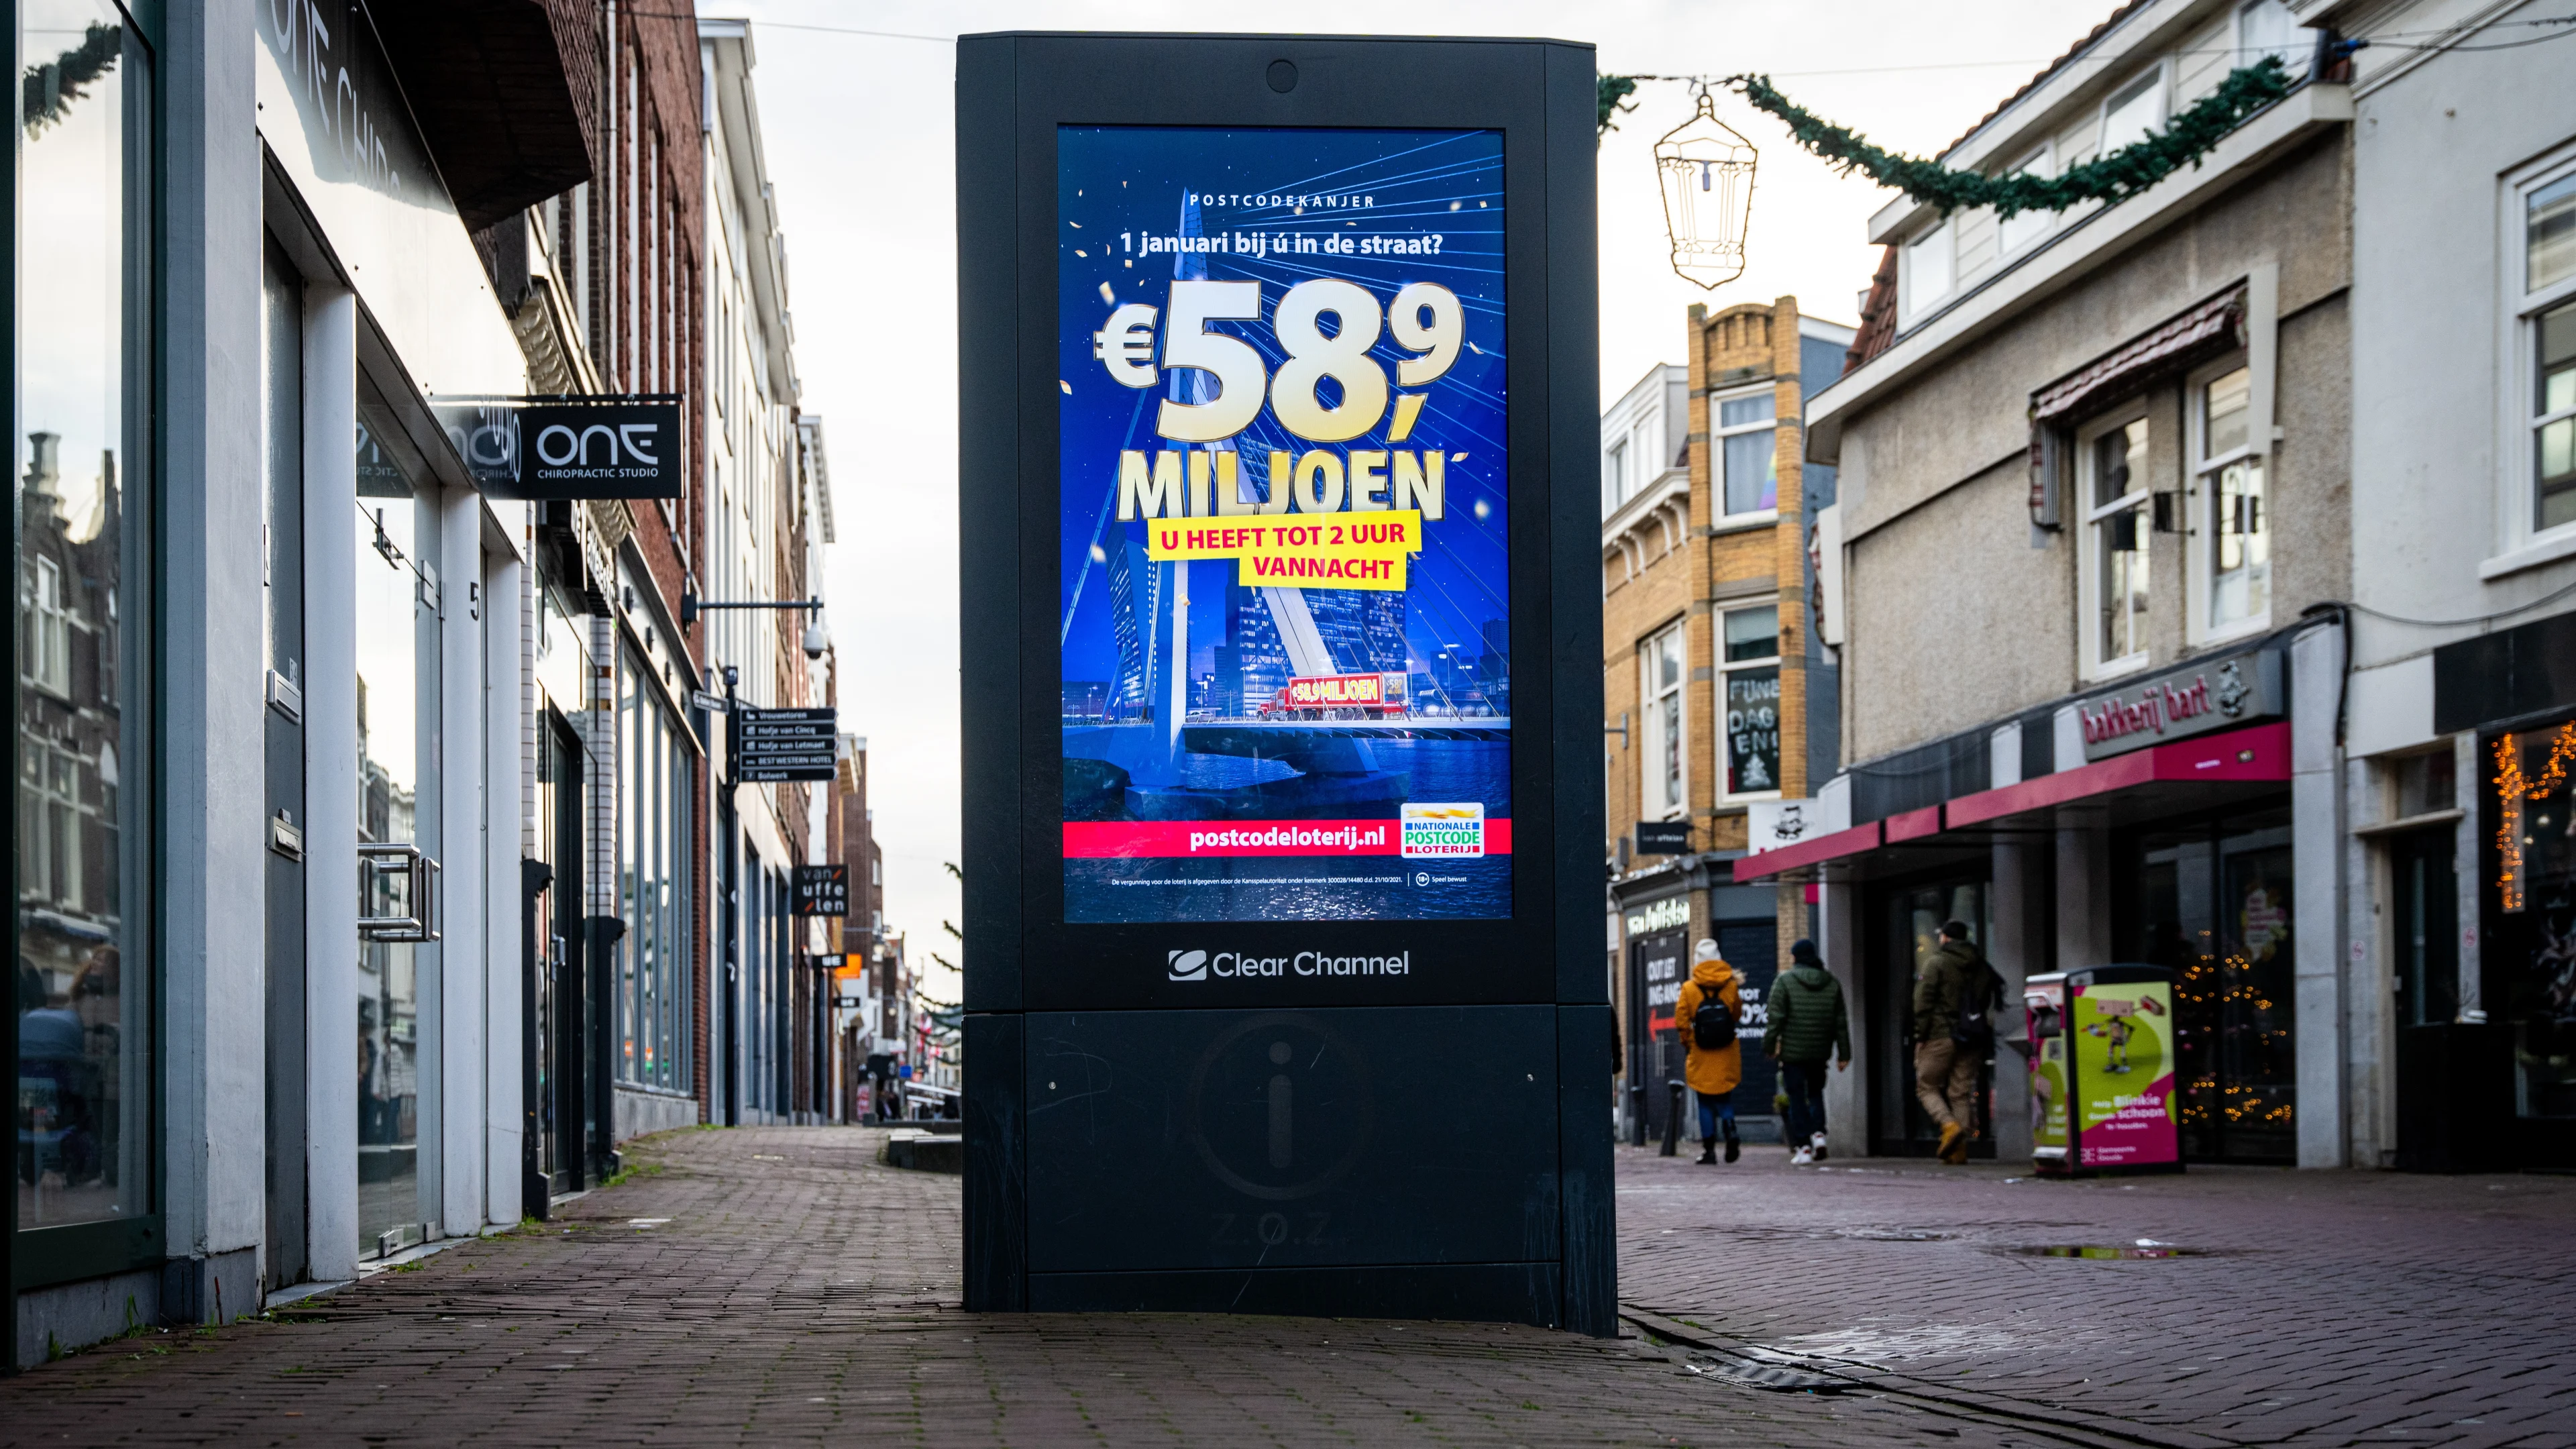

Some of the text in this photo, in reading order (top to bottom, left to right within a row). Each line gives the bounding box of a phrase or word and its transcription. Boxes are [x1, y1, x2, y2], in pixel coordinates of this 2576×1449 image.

[1189, 195, 1375, 208] POSTCODEKANJER
[1121, 232, 1443, 258] 1 januari bij ú in de straat?
[538, 468, 658, 479] CHIROPRACTIC STUDIO
[1115, 449, 1446, 522] MILJOEN
[1161, 523, 1405, 550] U HEEFT TOT 2 UUR
[1253, 556, 1394, 580] VANNACHT
[1320, 679, 1378, 701] MILJOEN
[1728, 706, 1775, 734] DAG
[2082, 674, 2211, 744] bakkerij bart
[758, 727, 779, 737] Hofje
[758, 741, 779, 751] Hofje
[758, 756, 832, 765] BEST WESTERN HOTEL
[1190, 826, 1385, 851] postcodeloterij.nl
[1405, 831, 1480, 845] POSTCODE
[1415, 845, 1471, 853] LOTERIJ
[802, 881, 844, 897] uffe
[1213, 950, 1409, 977] Clear Channel
[1739, 1003, 1769, 1025] 0%
